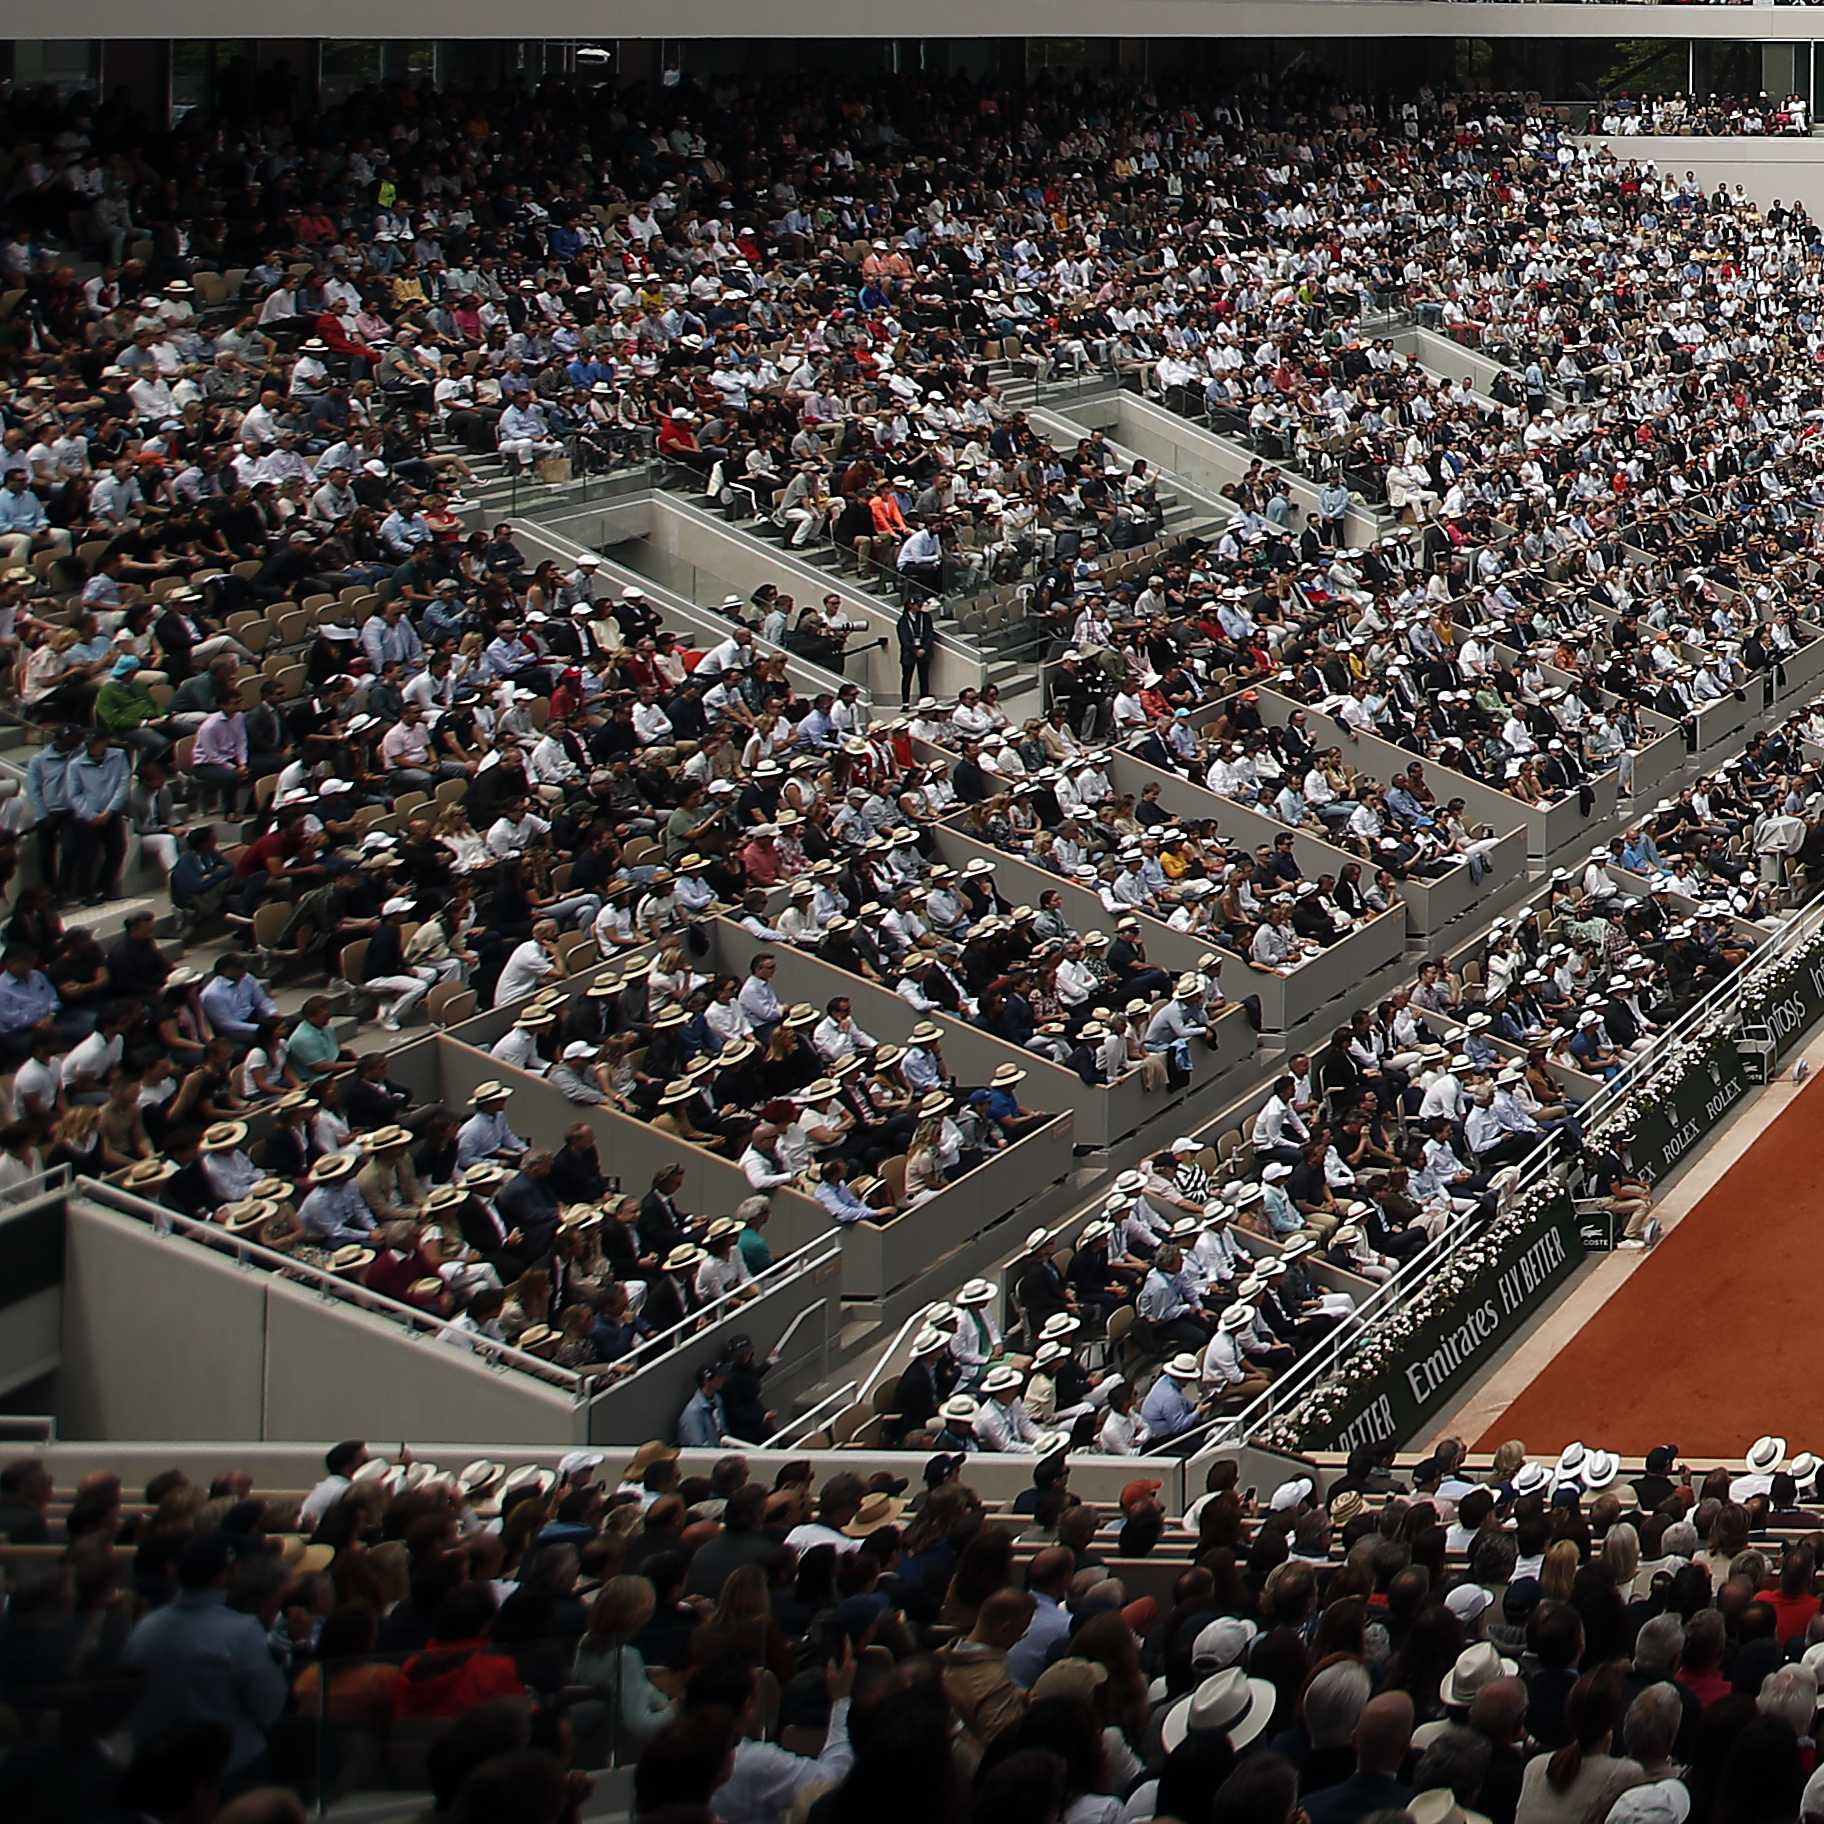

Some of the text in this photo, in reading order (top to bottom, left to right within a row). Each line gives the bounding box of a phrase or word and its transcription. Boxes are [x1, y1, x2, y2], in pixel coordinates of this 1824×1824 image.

[1705, 1077, 1743, 1122] ROLEX
[1661, 1118, 1701, 1165] ROLEX
[1405, 1225, 1567, 1405] Emirates FLY BETTER
[1338, 1393, 1397, 1452] BETTER
